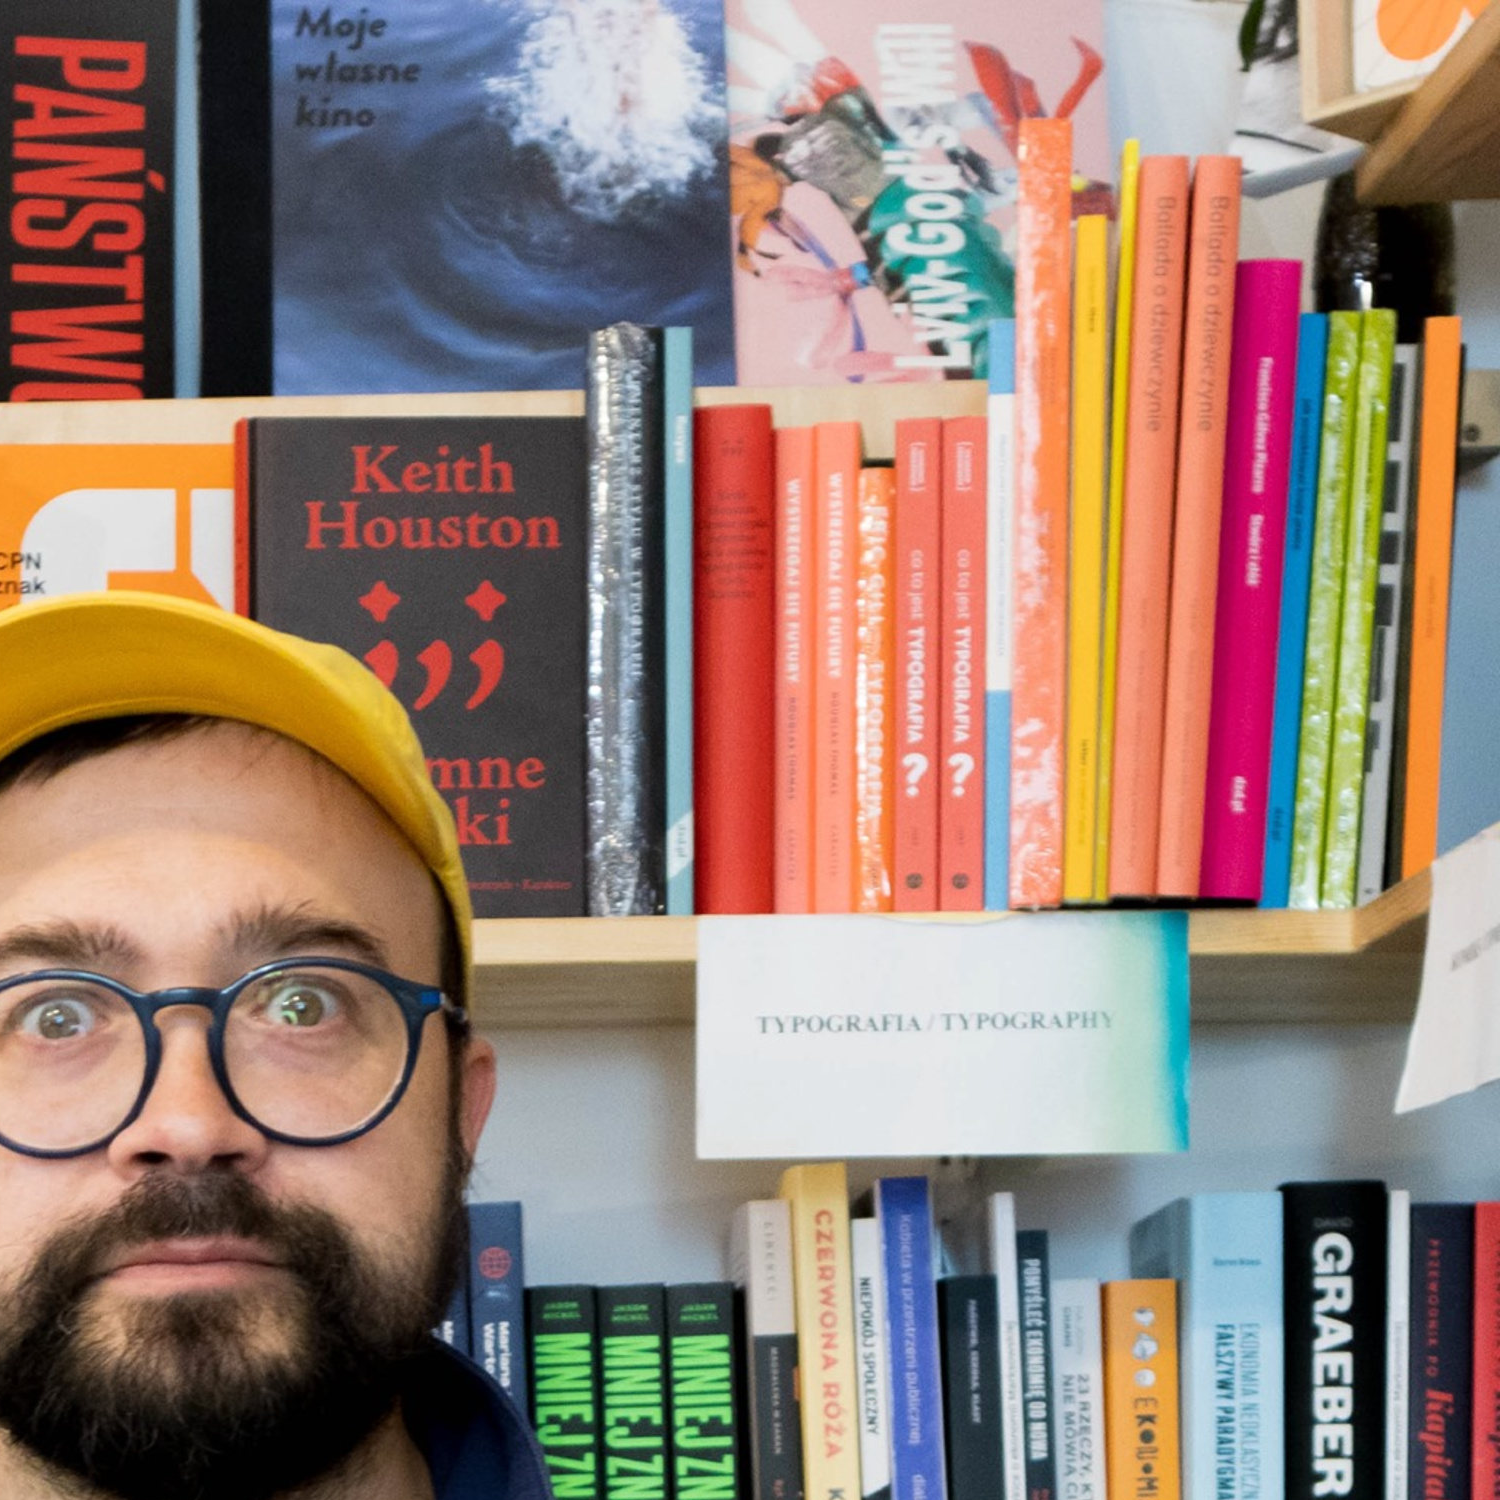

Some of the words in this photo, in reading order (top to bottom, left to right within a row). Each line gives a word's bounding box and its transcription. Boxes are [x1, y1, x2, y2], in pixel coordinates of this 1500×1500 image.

[295, 7, 387, 50] Moje
[295, 50, 422, 83] własne
[873, 24, 957, 106] Will
[295, 95, 377, 127] kino
[1153, 195, 1177, 278] Ballada
[1205, 195, 1230, 278] Ballada
[1154, 283, 1169, 297] o
[1206, 283, 1221, 297] o
[1146, 303, 1170, 433] dziewczynie
[1197, 303, 1224, 433] dziewczynie
[352, 445, 515, 495] Keith
[306, 501, 564, 550] Houston
[784, 478, 801, 588] WYSTRZEGAJ
[827, 473, 843, 583] WYSTRZEGAJ
[957, 549, 972, 568] co
[911, 549, 925, 569] co
[911, 571, 926, 590] to
[957, 571, 973, 589] to
[907, 591, 926, 621] jest
[954, 591, 973, 620] jest
[784, 621, 800, 684] FUTURY
[827, 615, 843, 679] FUTURY
[906, 626, 926, 744] TYPOGRAFIA
[952, 626, 972, 743] TYPOGRAFIA
[427, 755, 547, 789] mne
[459, 798, 513, 845] ki
[758, 1015, 922, 1035] TYPOGRAFIA
[941, 1011, 1114, 1032] TYPOGRAPHY
[898, 1213, 913, 1269] Kobieta
[814, 1208, 843, 1372] CZERWONA
[859, 1276, 877, 1348] NIEPOKÓJ
[1022, 1257, 1047, 1327] POMYŚLEĆ
[1427, 1237, 1441, 1347] PRZEWODNIK
[900, 1287, 917, 1368] przestrzeni
[1239, 1322, 1261, 1397] EKONOMIA
[534, 1332, 594, 1446] MNIEJ
[603, 1334, 664, 1449] MNIEJ
[670, 1334, 733, 1449] MNIEJ
[862, 1351, 880, 1436] SPOŁECZNY
[1024, 1328, 1047, 1398] EKONOMIĘ
[1062, 1373, 1076, 1404] NIE
[1077, 1372, 1091, 1395] 23
[1214, 1323, 1238, 1401] FAŁSZYWY
[1312, 1232, 1354, 1498] GRAEBER
[1425, 1354, 1439, 1379] PO
[822, 1381, 851, 1460] RÓŻA
[903, 1371, 921, 1446] publicznej
[1027, 1400, 1047, 1419] OD
[1030, 1420, 1049, 1460] NOWA
[1077, 1401, 1094, 1476] RZECZY,
[1062, 1410, 1079, 1476] MÓWIĄ
[1065, 1480, 1077, 1499] CI
